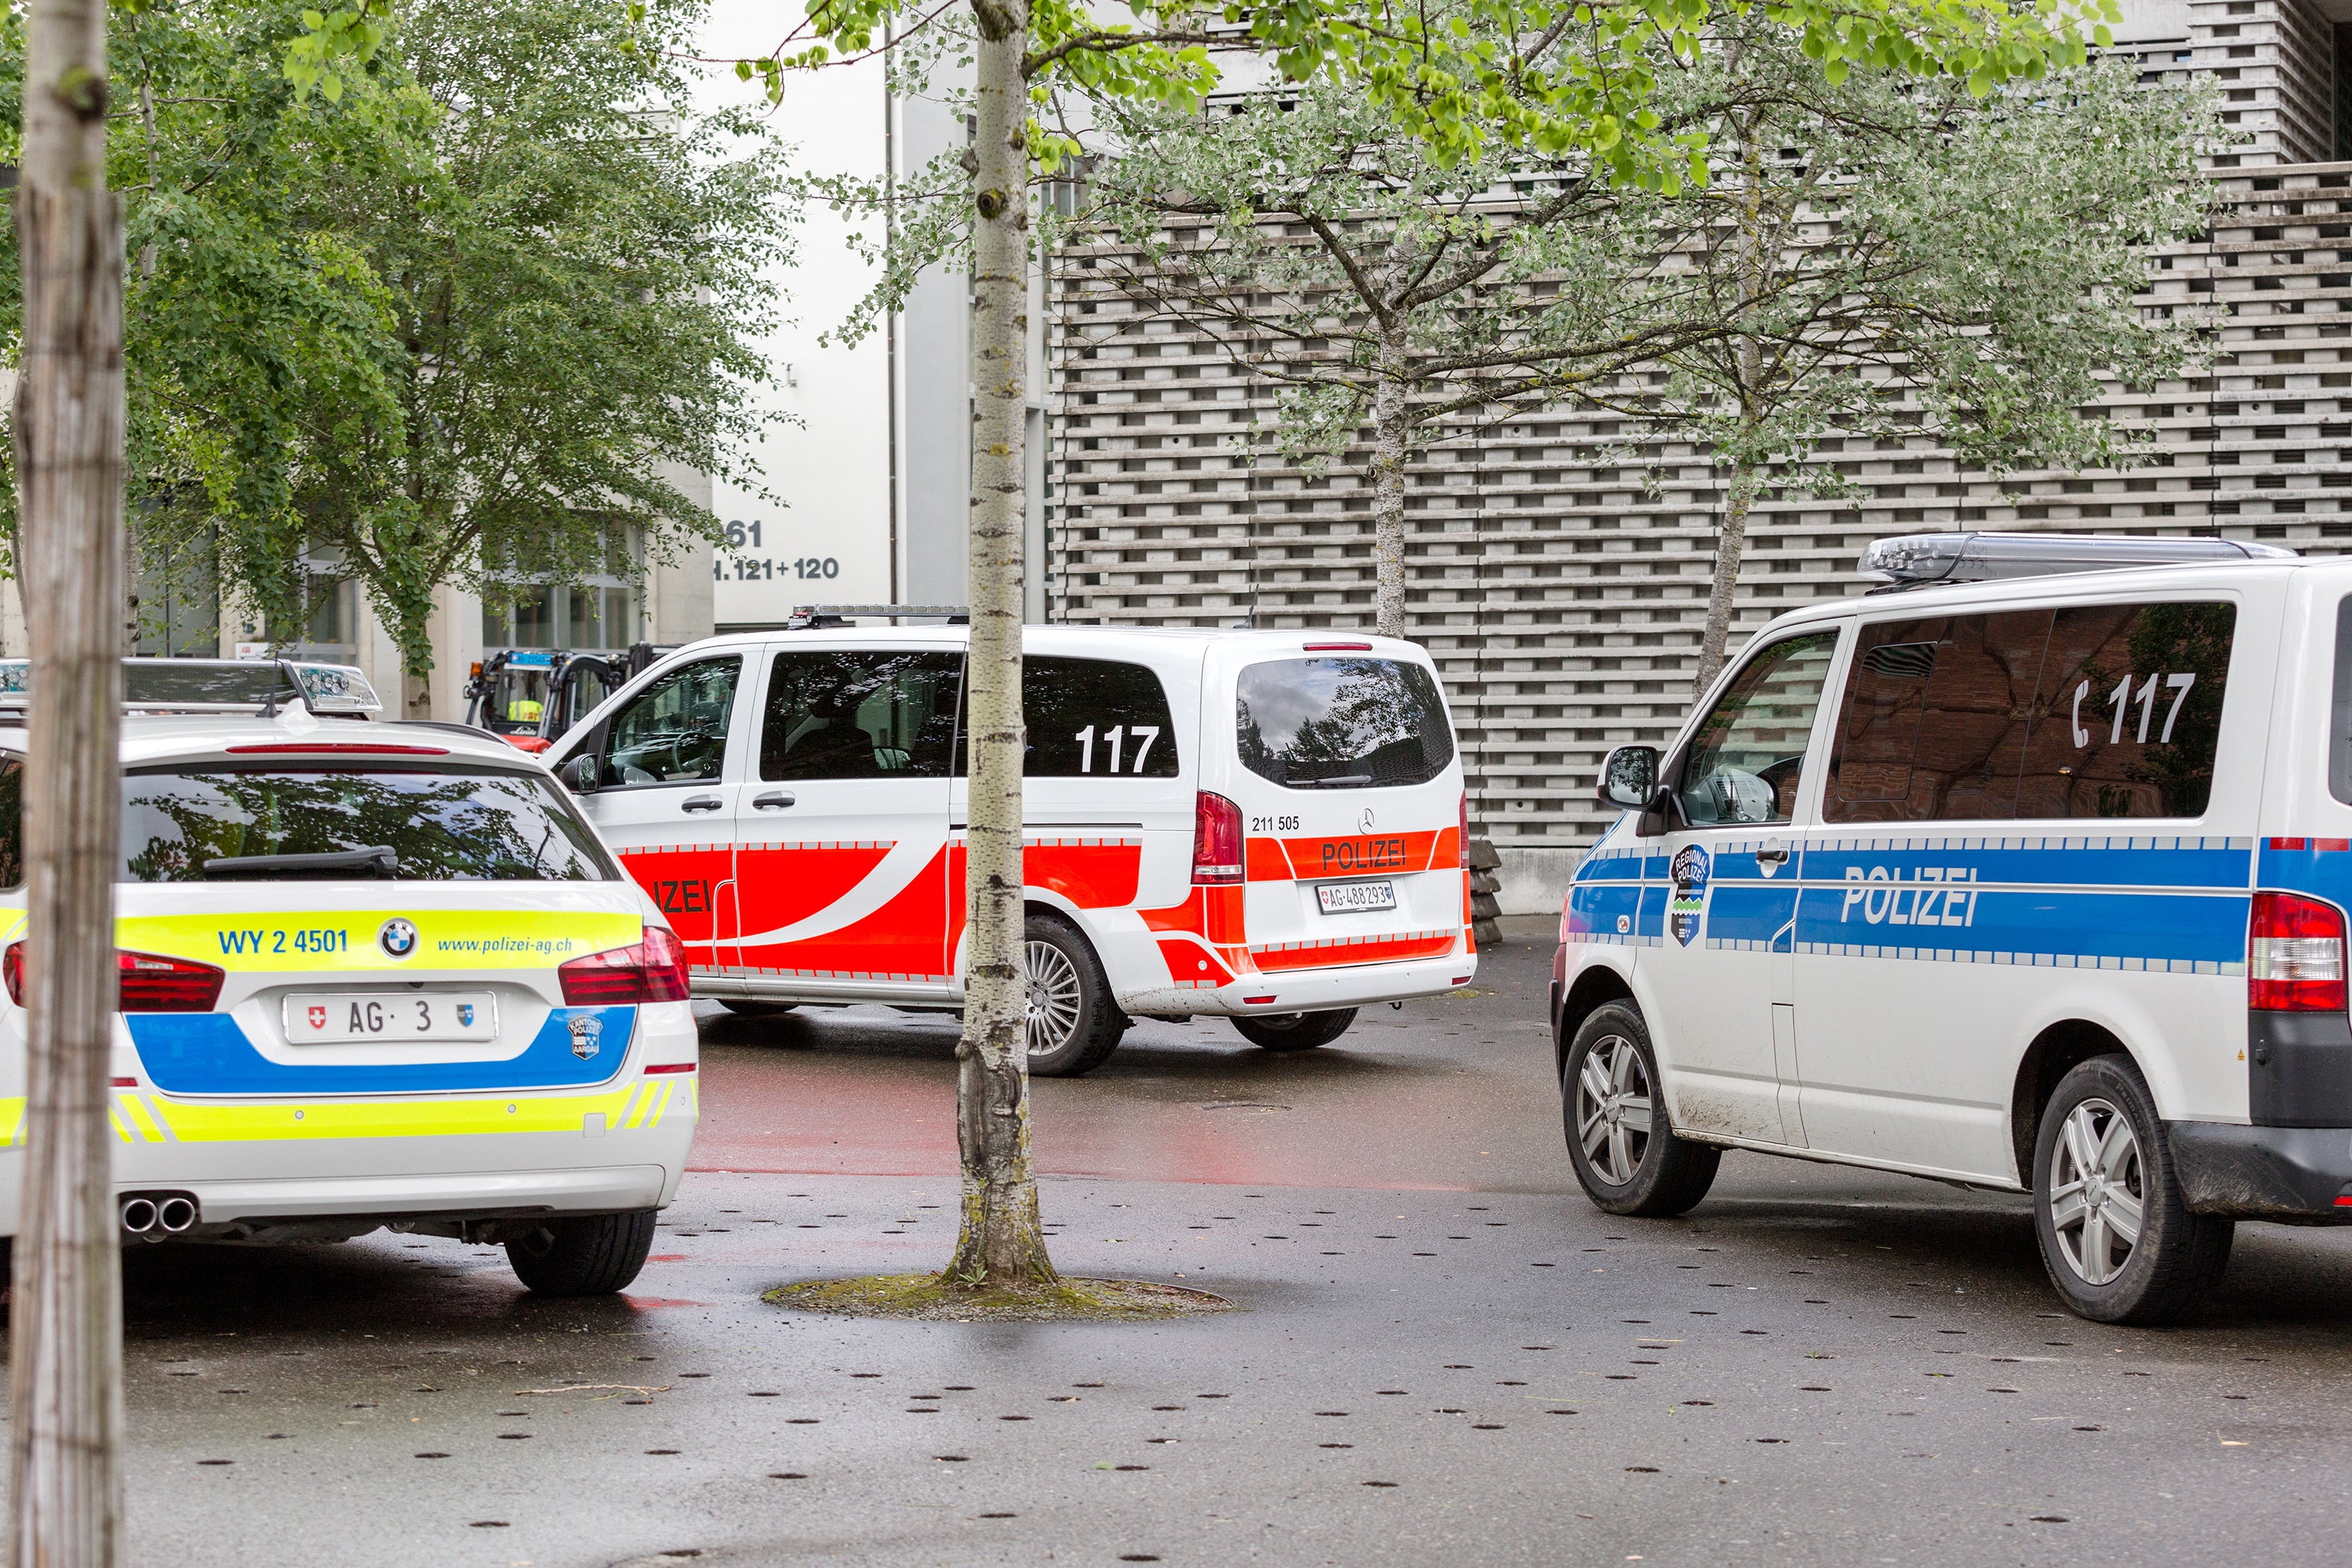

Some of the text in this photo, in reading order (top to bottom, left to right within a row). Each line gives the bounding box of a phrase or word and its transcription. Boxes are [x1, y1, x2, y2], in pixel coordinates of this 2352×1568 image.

[714, 520, 761, 547] 61
[2108, 673, 2196, 744] 117
[510, 725, 537, 736] Linde
[1075, 725, 1160, 773] 117
[1252, 816, 1299, 831] 211 505
[1322, 839, 1406, 870] POLIZEI
[1675, 849, 1708, 874] REGIONAL
[1677, 864, 1704, 884] POLIZEI
[1840, 866, 1978, 927] POLIZEI
[218, 929, 348, 955] WY 2 4501
[438, 936, 573, 956] www.polizei-ag.ch
[1774, 942, 1790, 952] Diesel
[416, 1000, 432, 1031] 3
[569, 1019, 601, 1030] KANTONS
[573, 1025, 598, 1035] POLIZEI
